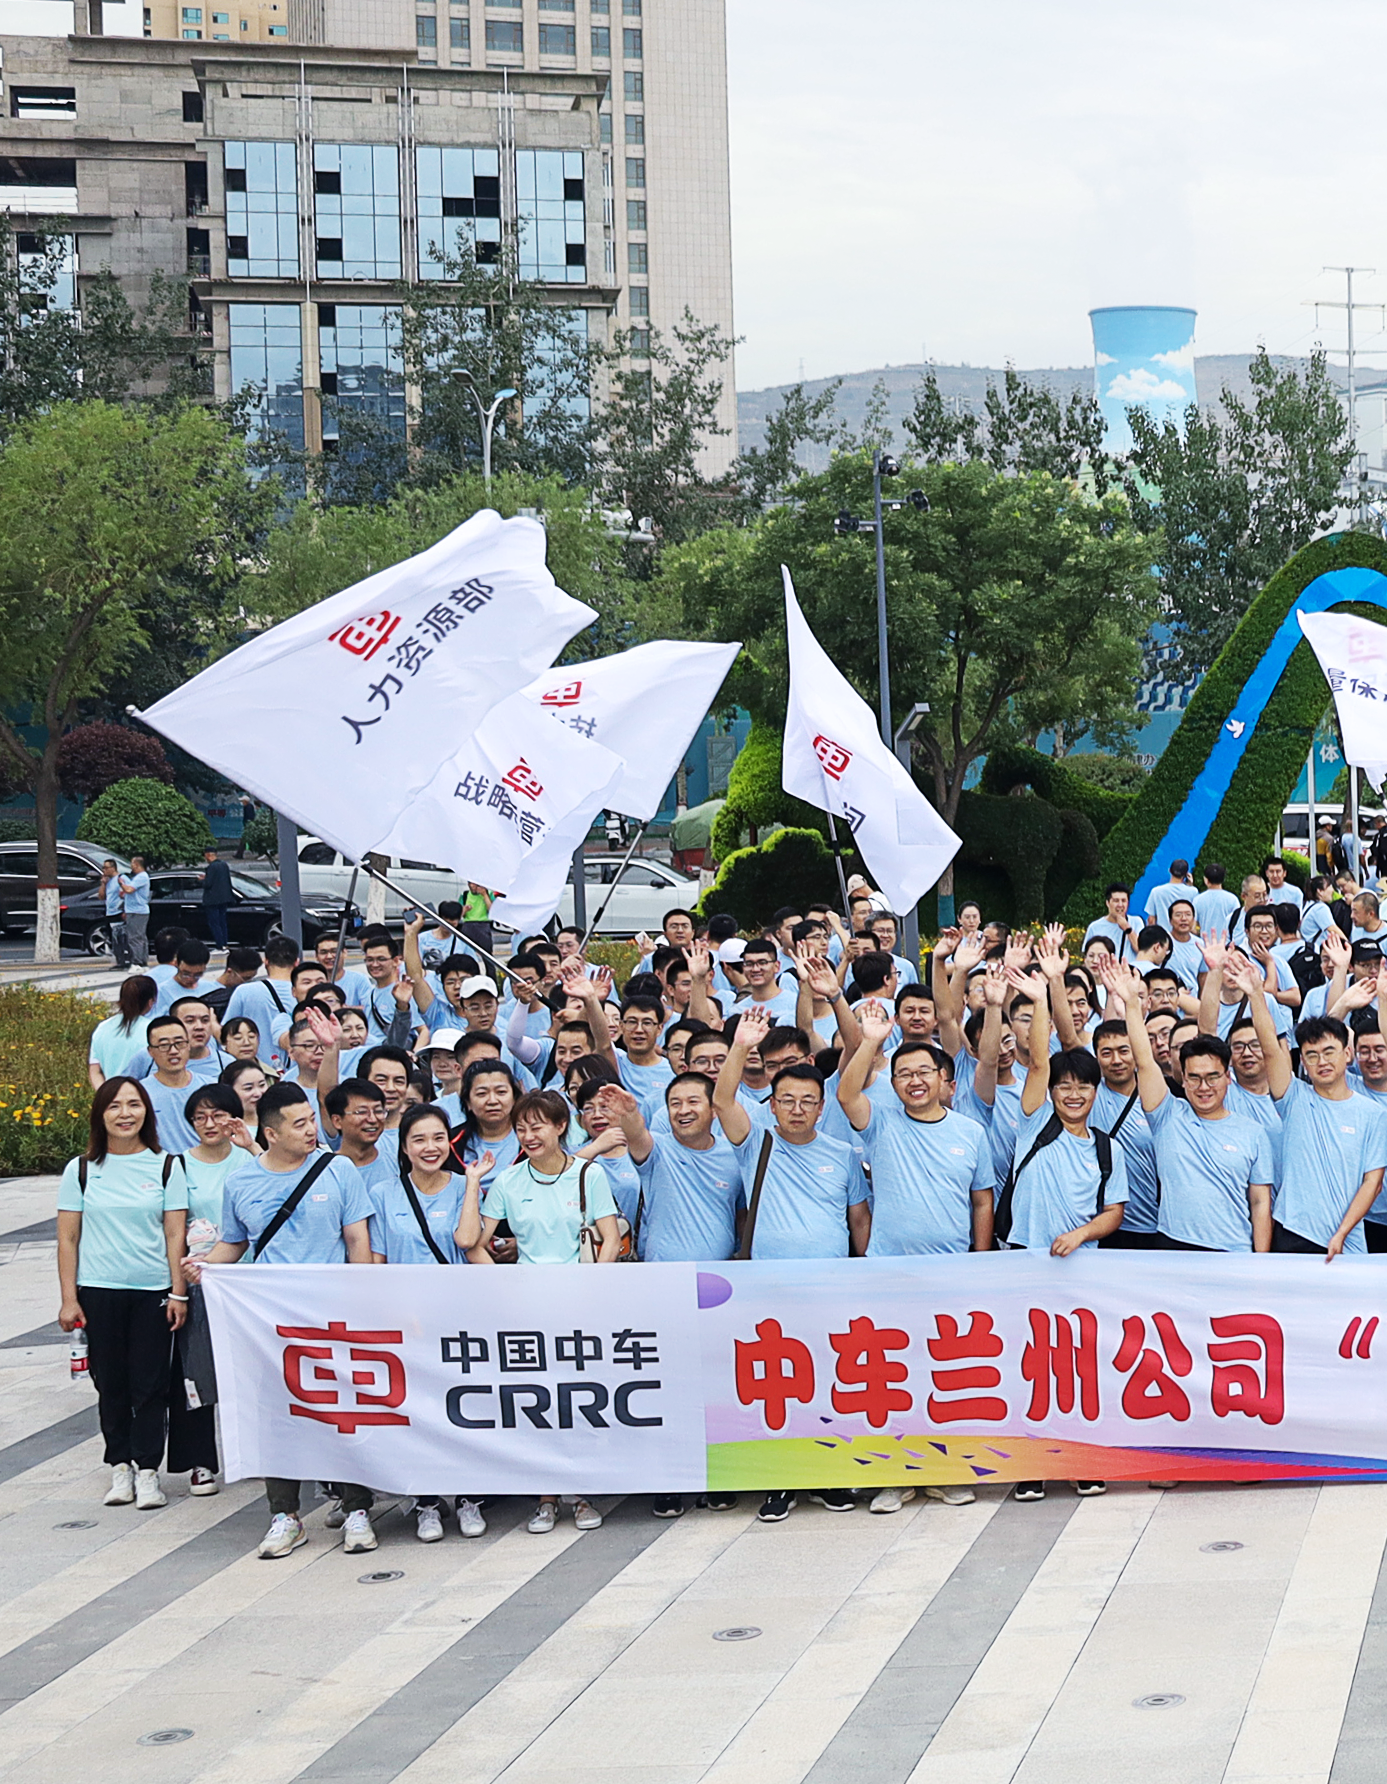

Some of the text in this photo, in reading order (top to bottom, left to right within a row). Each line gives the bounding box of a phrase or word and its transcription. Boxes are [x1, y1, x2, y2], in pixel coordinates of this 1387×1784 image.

[341, 578, 494, 745] 人力资源部
[440, 1328, 660, 1374] 中国中车
[735, 1308, 1285, 1431] 中车兰州公司
[445, 1380, 663, 1430] CRRC
